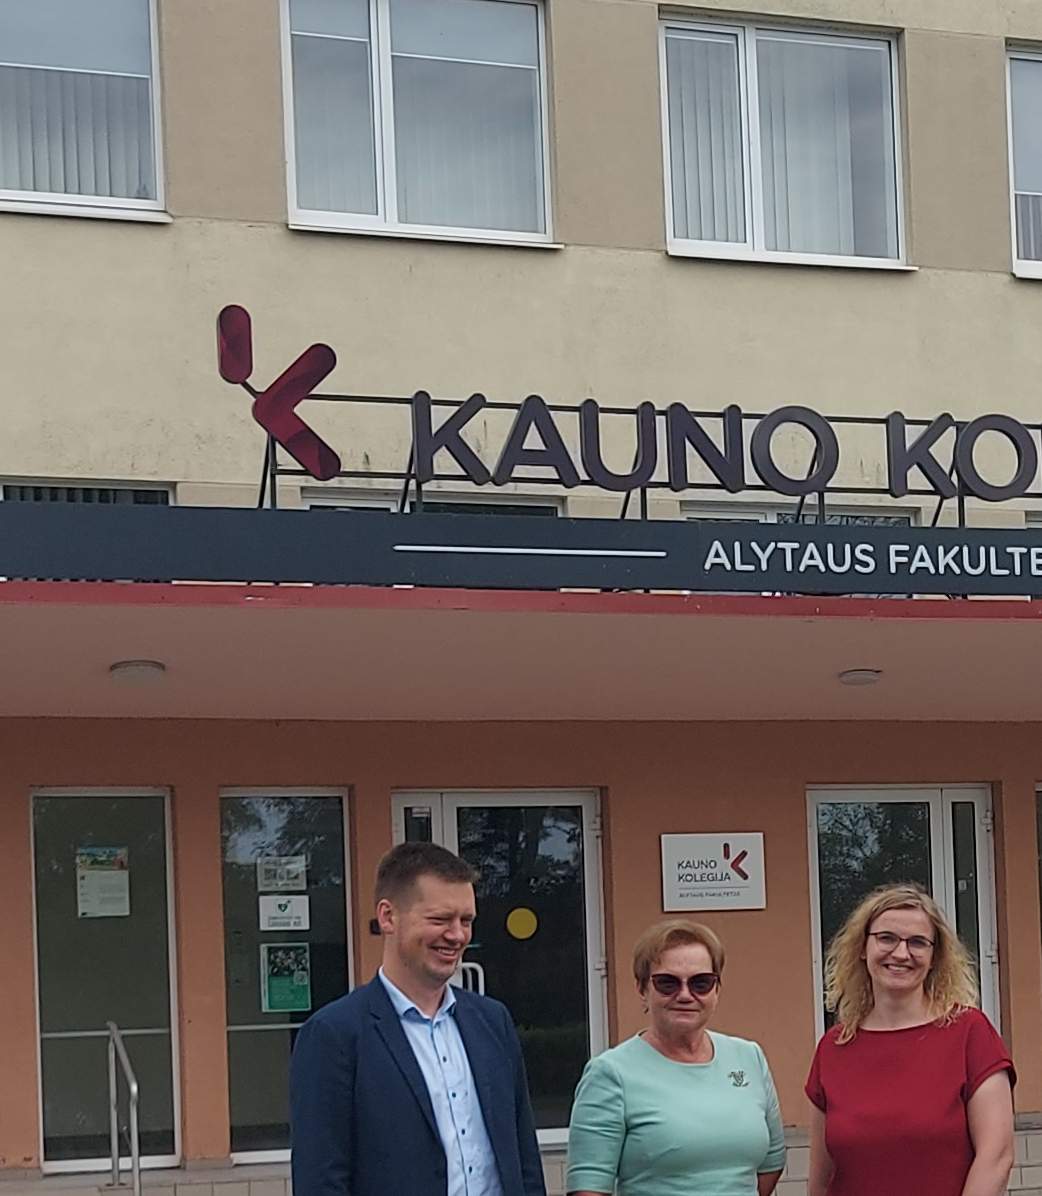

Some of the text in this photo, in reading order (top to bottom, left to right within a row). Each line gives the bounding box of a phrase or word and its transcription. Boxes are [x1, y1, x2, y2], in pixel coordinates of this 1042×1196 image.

[411, 390, 839, 496] KAUNO
[704, 540, 876, 574] ALYTAUS
[677, 859, 718, 870] KAUNO
[677, 872, 732, 883] KOLEGIJA
